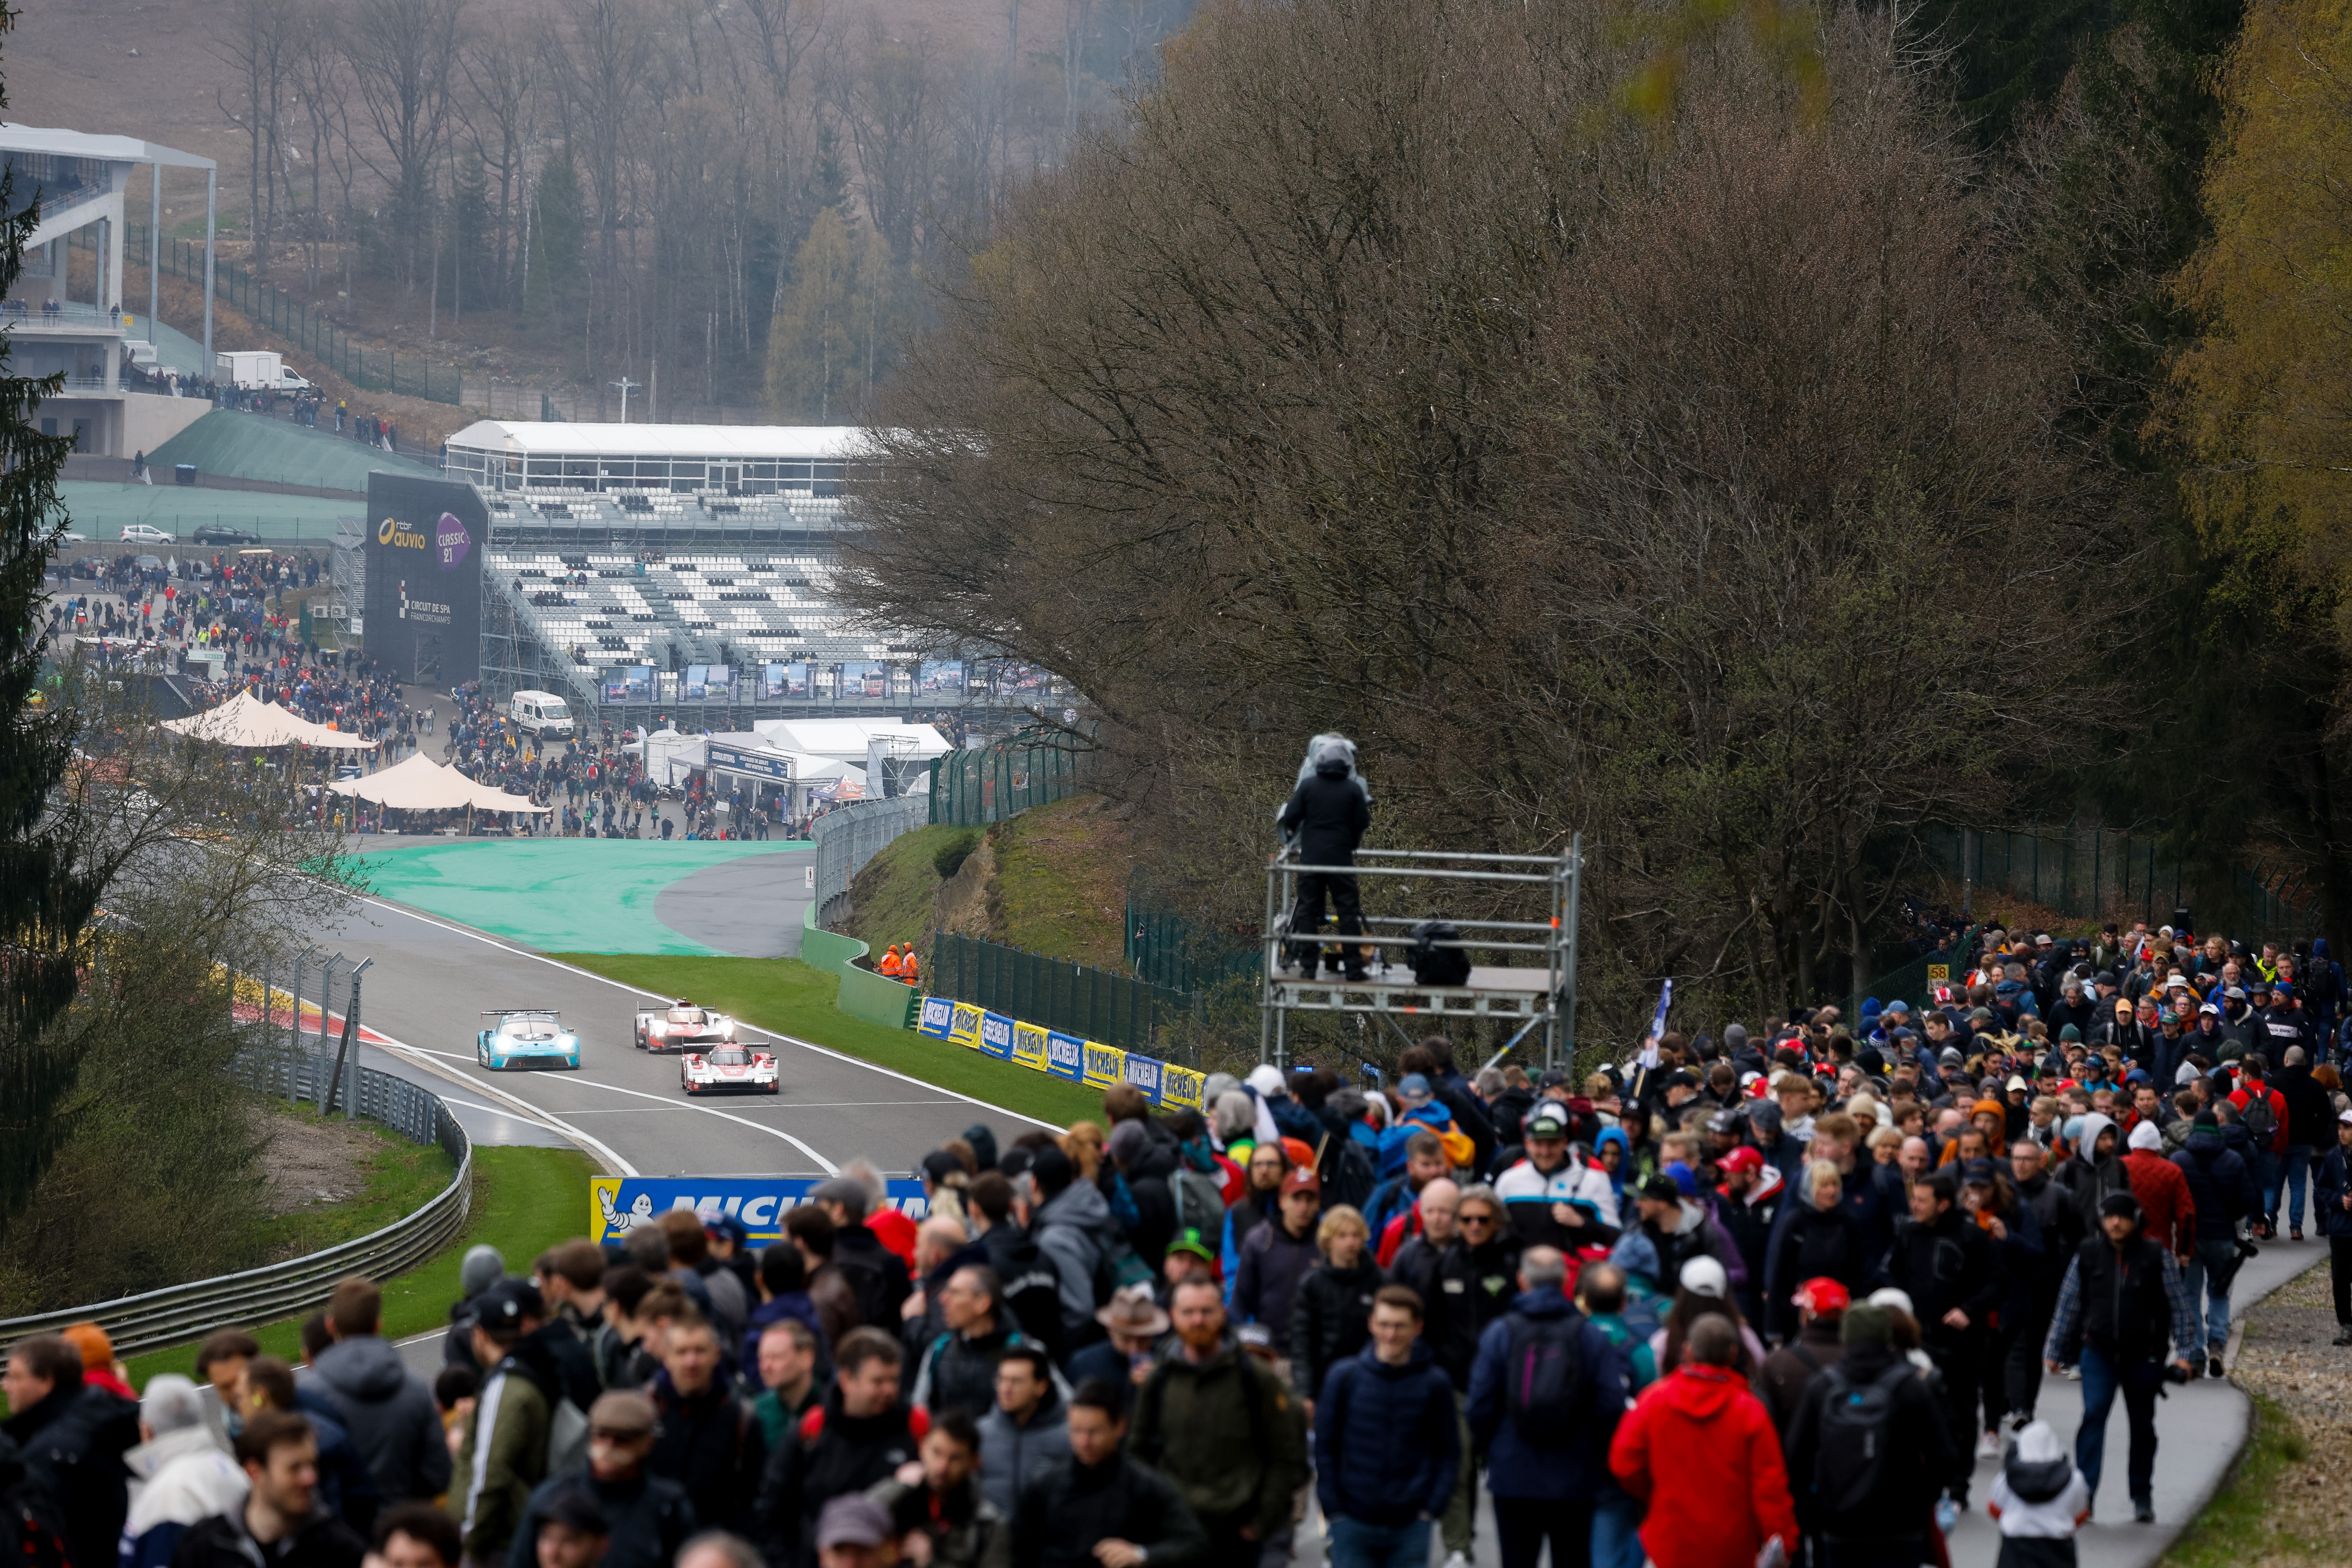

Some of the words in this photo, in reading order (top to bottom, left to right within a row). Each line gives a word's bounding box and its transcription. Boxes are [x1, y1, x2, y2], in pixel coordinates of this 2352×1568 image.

[394, 532, 425, 549] auvio
[438, 532, 465, 547] CLASSIC
[443, 547, 453, 563] 21
[410, 612, 451, 624] FRANCORCHAMPS
[411, 601, 432, 612] CIRCUIT
[432, 603, 440, 613] DE
[440, 604, 451, 614] SPA
[1931, 967, 1946, 979] 58
[925, 1001, 951, 1027] MICHELIN
[985, 1019, 1010, 1046] MICHELIN
[1017, 1028, 1044, 1056] MICHELIN
[1051, 1038, 1079, 1067] MICHELIN
[1088, 1048, 1119, 1079] MICHELIN
[1128, 1060, 1158, 1089] MICHELIN
[1166, 1071, 1197, 1101] MICHELIN
